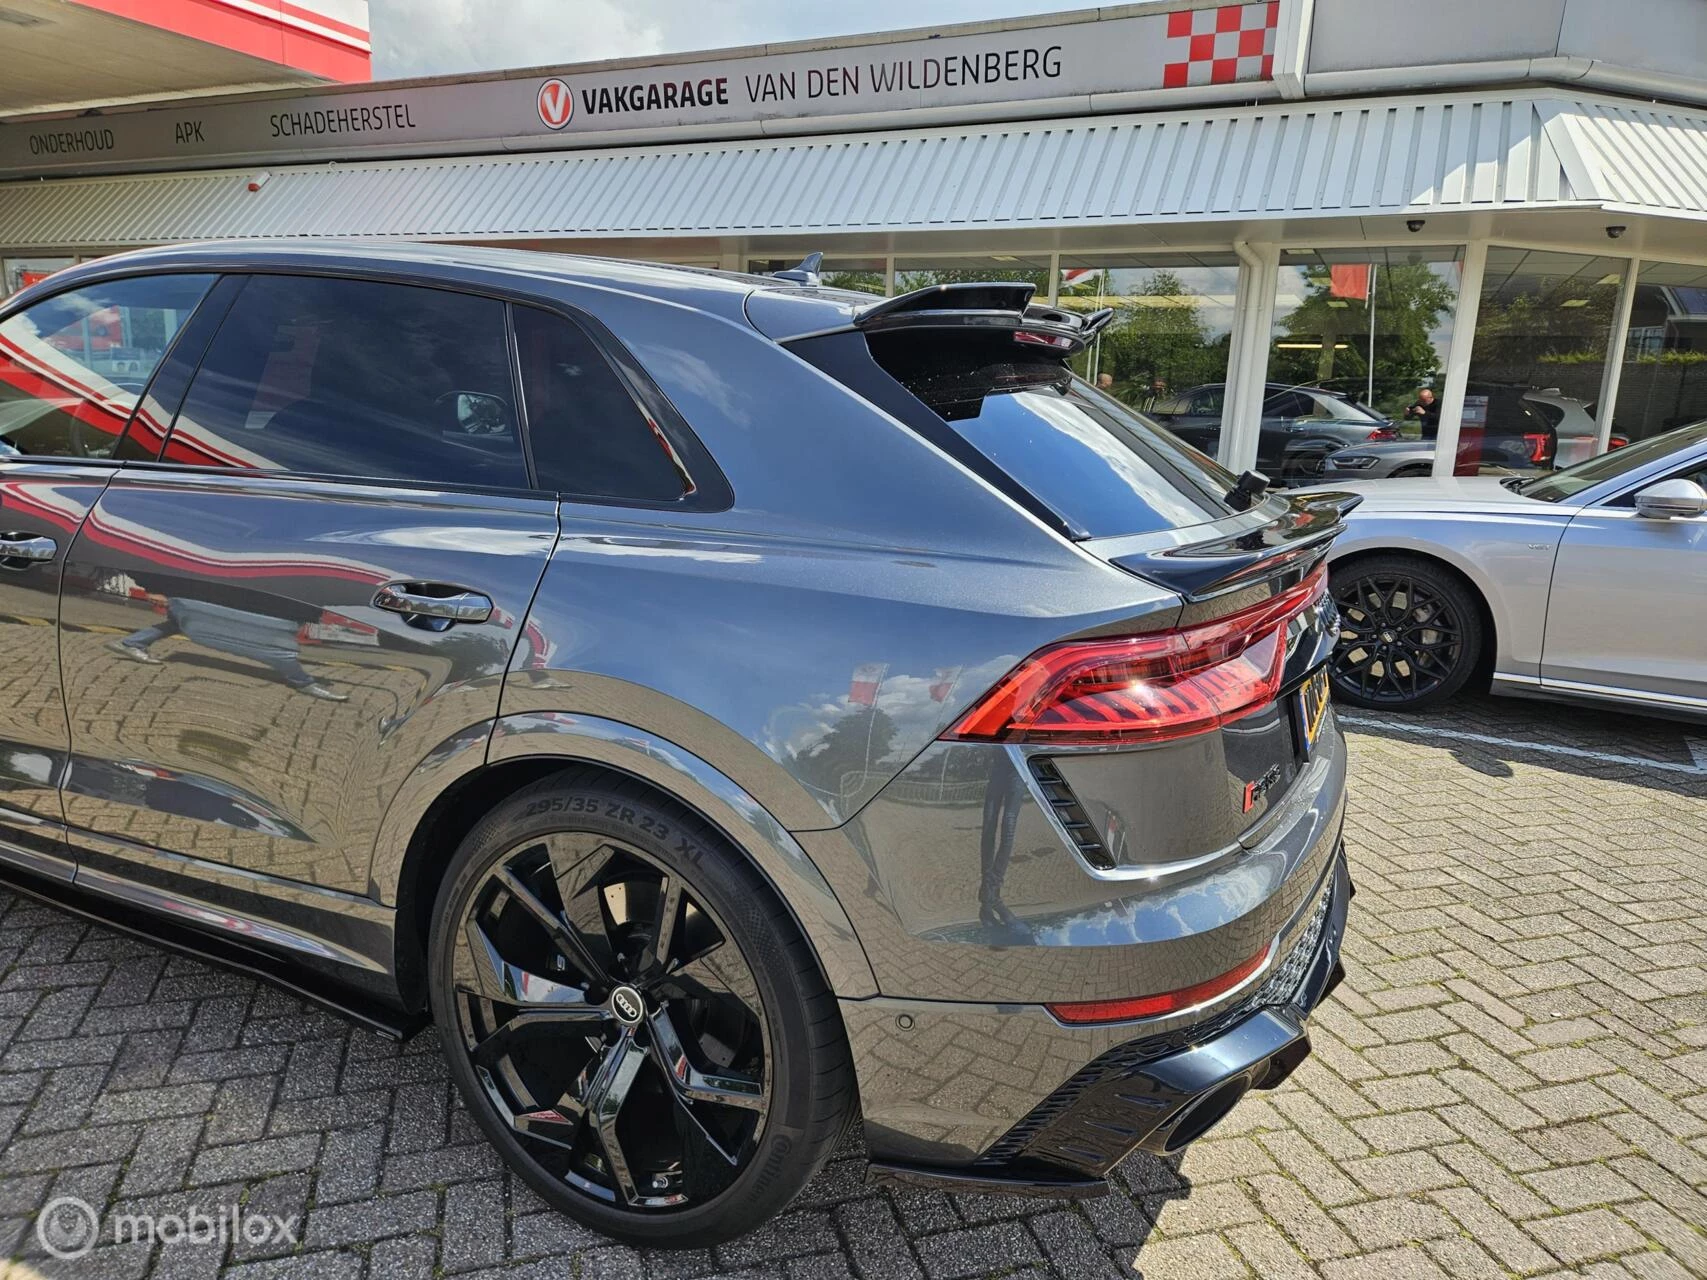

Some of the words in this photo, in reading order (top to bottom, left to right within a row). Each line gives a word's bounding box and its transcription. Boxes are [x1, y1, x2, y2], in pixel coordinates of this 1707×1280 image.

[581, 77, 729, 115] VAKGARAGE
[745, 71, 796, 103] VAN
[807, 65, 859, 99] DEN
[869, 45, 1062, 93] WILDENBERG
[175, 121, 205, 144] APK
[269, 103, 416, 138] SCHADEHERSTEL
[29, 128, 115, 156] ONDERHOUD
[525, 796, 599, 818] 295/35
[604, 802, 636, 825] ZR
[638, 815, 670, 841] 23
[674, 835, 706, 872] XL
